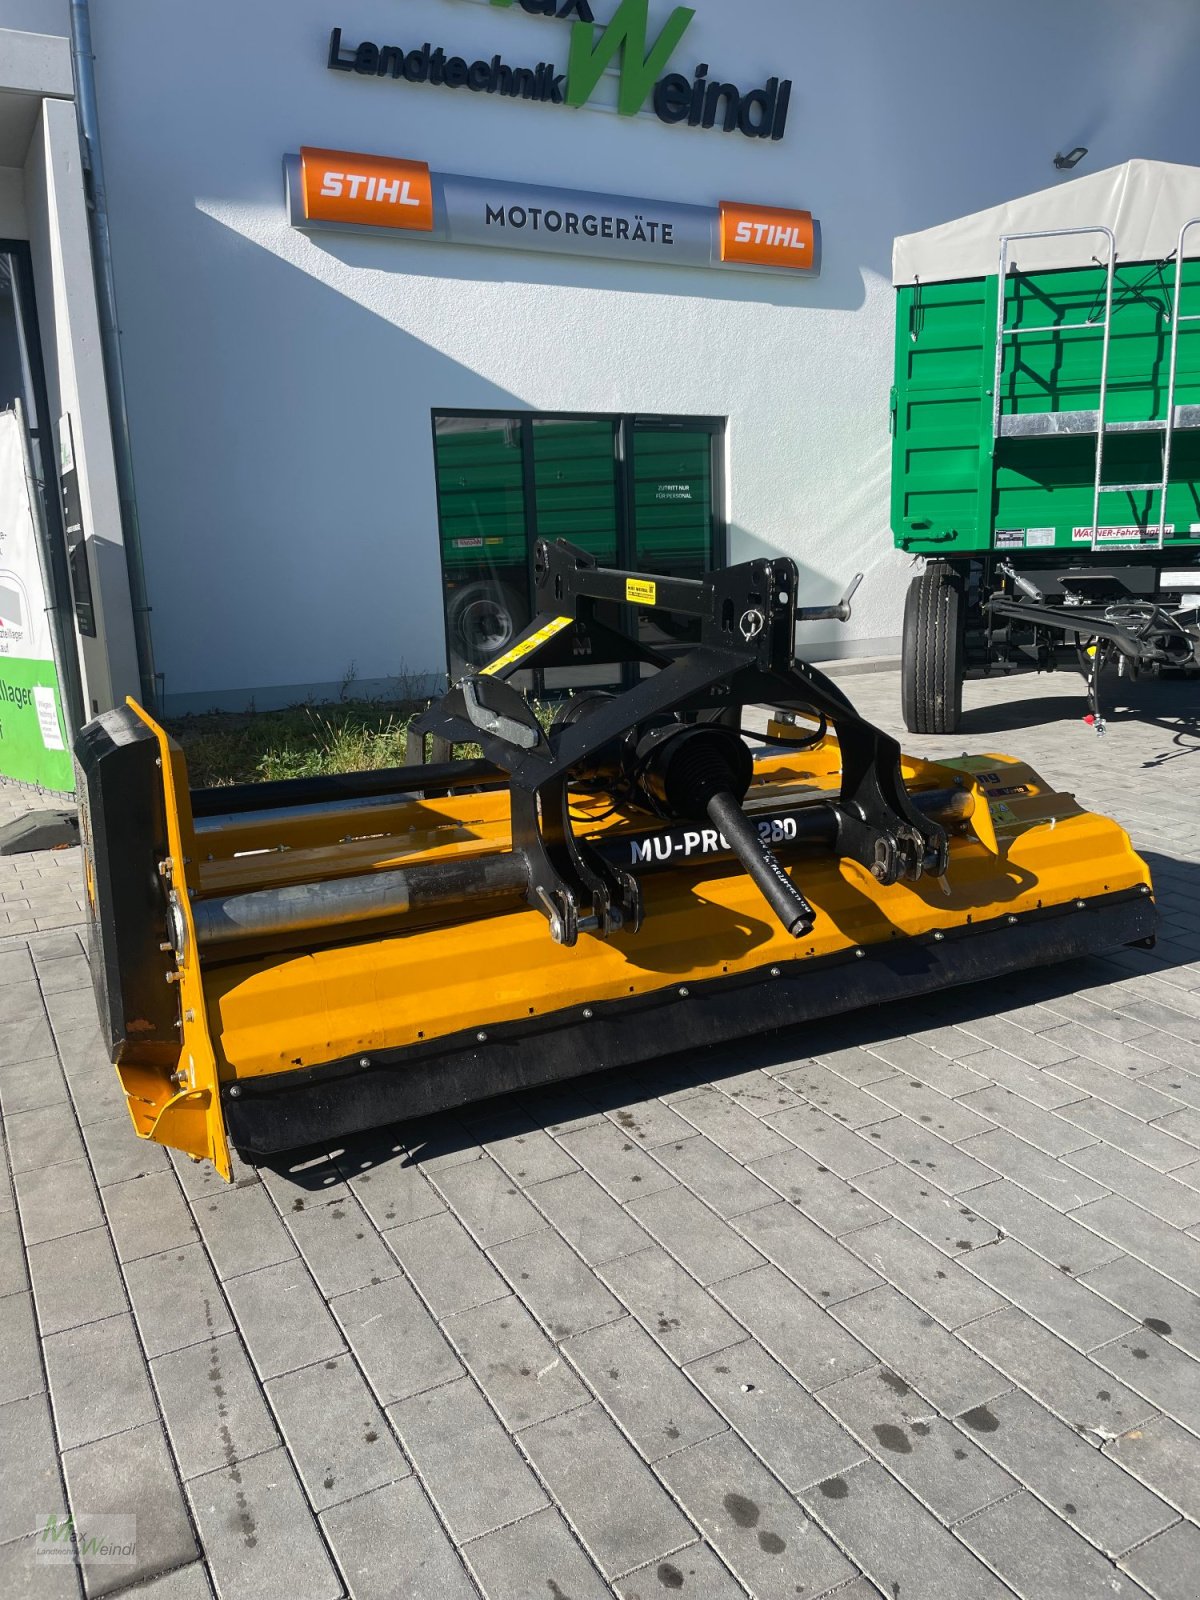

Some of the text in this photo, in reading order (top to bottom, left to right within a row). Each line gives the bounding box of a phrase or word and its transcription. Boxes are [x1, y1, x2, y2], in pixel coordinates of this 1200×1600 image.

[327, 0, 793, 141] Landtechnik Weindl
[319, 171, 806, 250] STIHL MOTORGERÄTE STIHL
[0, 679, 32, 710] llager
[758, 817, 797, 844] 280
